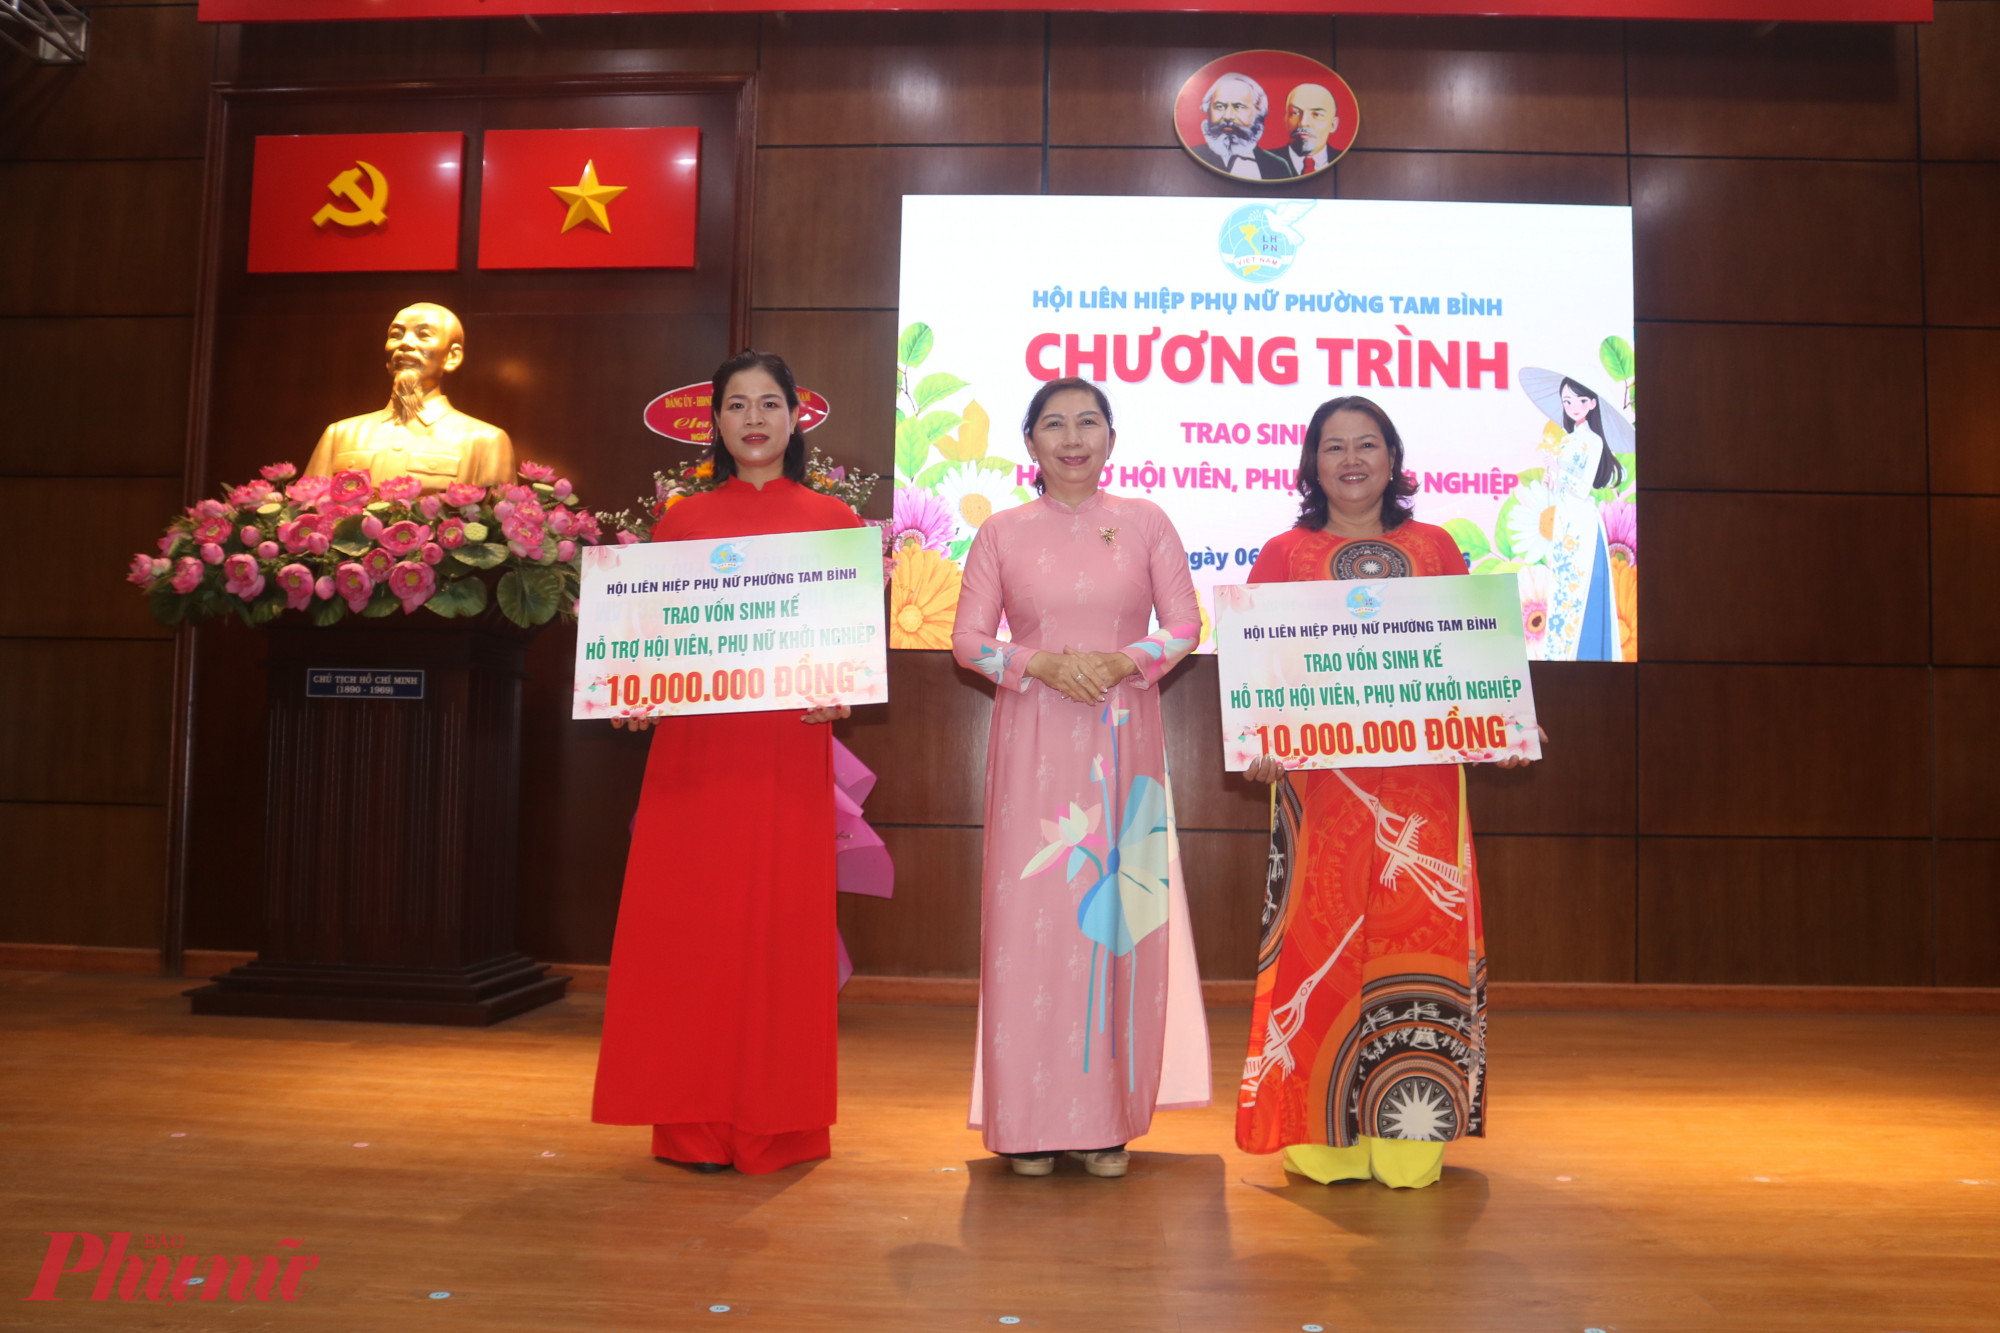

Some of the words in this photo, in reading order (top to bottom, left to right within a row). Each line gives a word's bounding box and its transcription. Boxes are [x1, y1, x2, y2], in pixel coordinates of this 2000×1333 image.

[1032, 285, 1073, 312] HỘI
[1080, 286, 1127, 309] LIÊN
[1134, 286, 1185, 314] HIỆP
[1190, 292, 1237, 315] PHỤ
[1244, 288, 1280, 311] NỮ
[1286, 290, 1384, 314] PHƯỜNG
[1390, 296, 1440, 315] TAM
[1447, 292, 1502, 316] BÌNH
[1025, 326, 1299, 386] CHƯƠNG
[1316, 324, 1509, 390] TRÌNH
[1180, 422, 1251, 444] TRAO
[1120, 460, 1166, 494] HỘI
[1172, 461, 1238, 493] VIÊN,
[1246, 468, 1299, 496] PHỤ
[1424, 466, 1520, 501] NGHIỆP
[607, 581, 627, 596] HỘI
[631, 580, 658, 594] LIÊN
[662, 578, 690, 594] HIỆP
[694, 578, 718, 592] PHỤ
[722, 575, 741, 588] NỮ
[744, 571, 794, 587] PHƯỜNG
[798, 570, 822, 583] TAM
[827, 567, 857, 580] BÌNH
[662, 606, 700, 624] TRAO
[705, 598, 734, 622] VỐN
[740, 600, 776, 620] SINH
[780, 592, 800, 618] KẾ
[586, 635, 606, 660] HỖ
[611, 638, 640, 662] TRỢ
[644, 635, 669, 661] HỘI
[674, 633, 712, 656] VIÊN,
[718, 634, 748, 656] PHỤ
[753, 628, 776, 652] NỮ
[780, 624, 815, 650] KHỞI
[820, 622, 876, 648] NGHIỆP
[1244, 624, 1264, 642] HỘI
[1268, 624, 1296, 638] LIÊN
[1300, 622, 1328, 640] HIỆP
[1332, 624, 1358, 638] PHỤ
[1362, 620, 1380, 635] NỮ
[1382, 618, 1434, 634] PHƯỜNG
[1437, 619, 1463, 632] TAM
[1466, 616, 1498, 631] BÌNH
[1304, 652, 1342, 672] TRAO
[1346, 645, 1378, 672] VỐN
[1382, 650, 1420, 670] SINH
[1423, 642, 1444, 668] KẾ
[313, 672, 332, 684] CHỦ
[334, 676, 356, 684] TỊCH
[358, 672, 372, 684] HỒ
[374, 674, 392, 684] CHÍ
[394, 676, 418, 685] MINH
[336, 685, 361, 694] (1890
[370, 686, 394, 695] 1969)
[607, 667, 765, 706] 10.000.000
[774, 653, 856, 698] ĐỒNG
[1230, 682, 1252, 709] HỖ
[1256, 686, 1284, 712] TRỢ
[1290, 684, 1316, 711] HỘI
[1319, 682, 1360, 708] VIÊN,
[1364, 684, 1395, 708] PHỤ
[1399, 680, 1422, 703] NỮ
[1425, 675, 1462, 702] KHỞI
[1466, 675, 1522, 703] NGHIỆP
[1256, 719, 1418, 758] 10.000.000
[1424, 706, 1508, 752] ĐỒNG
